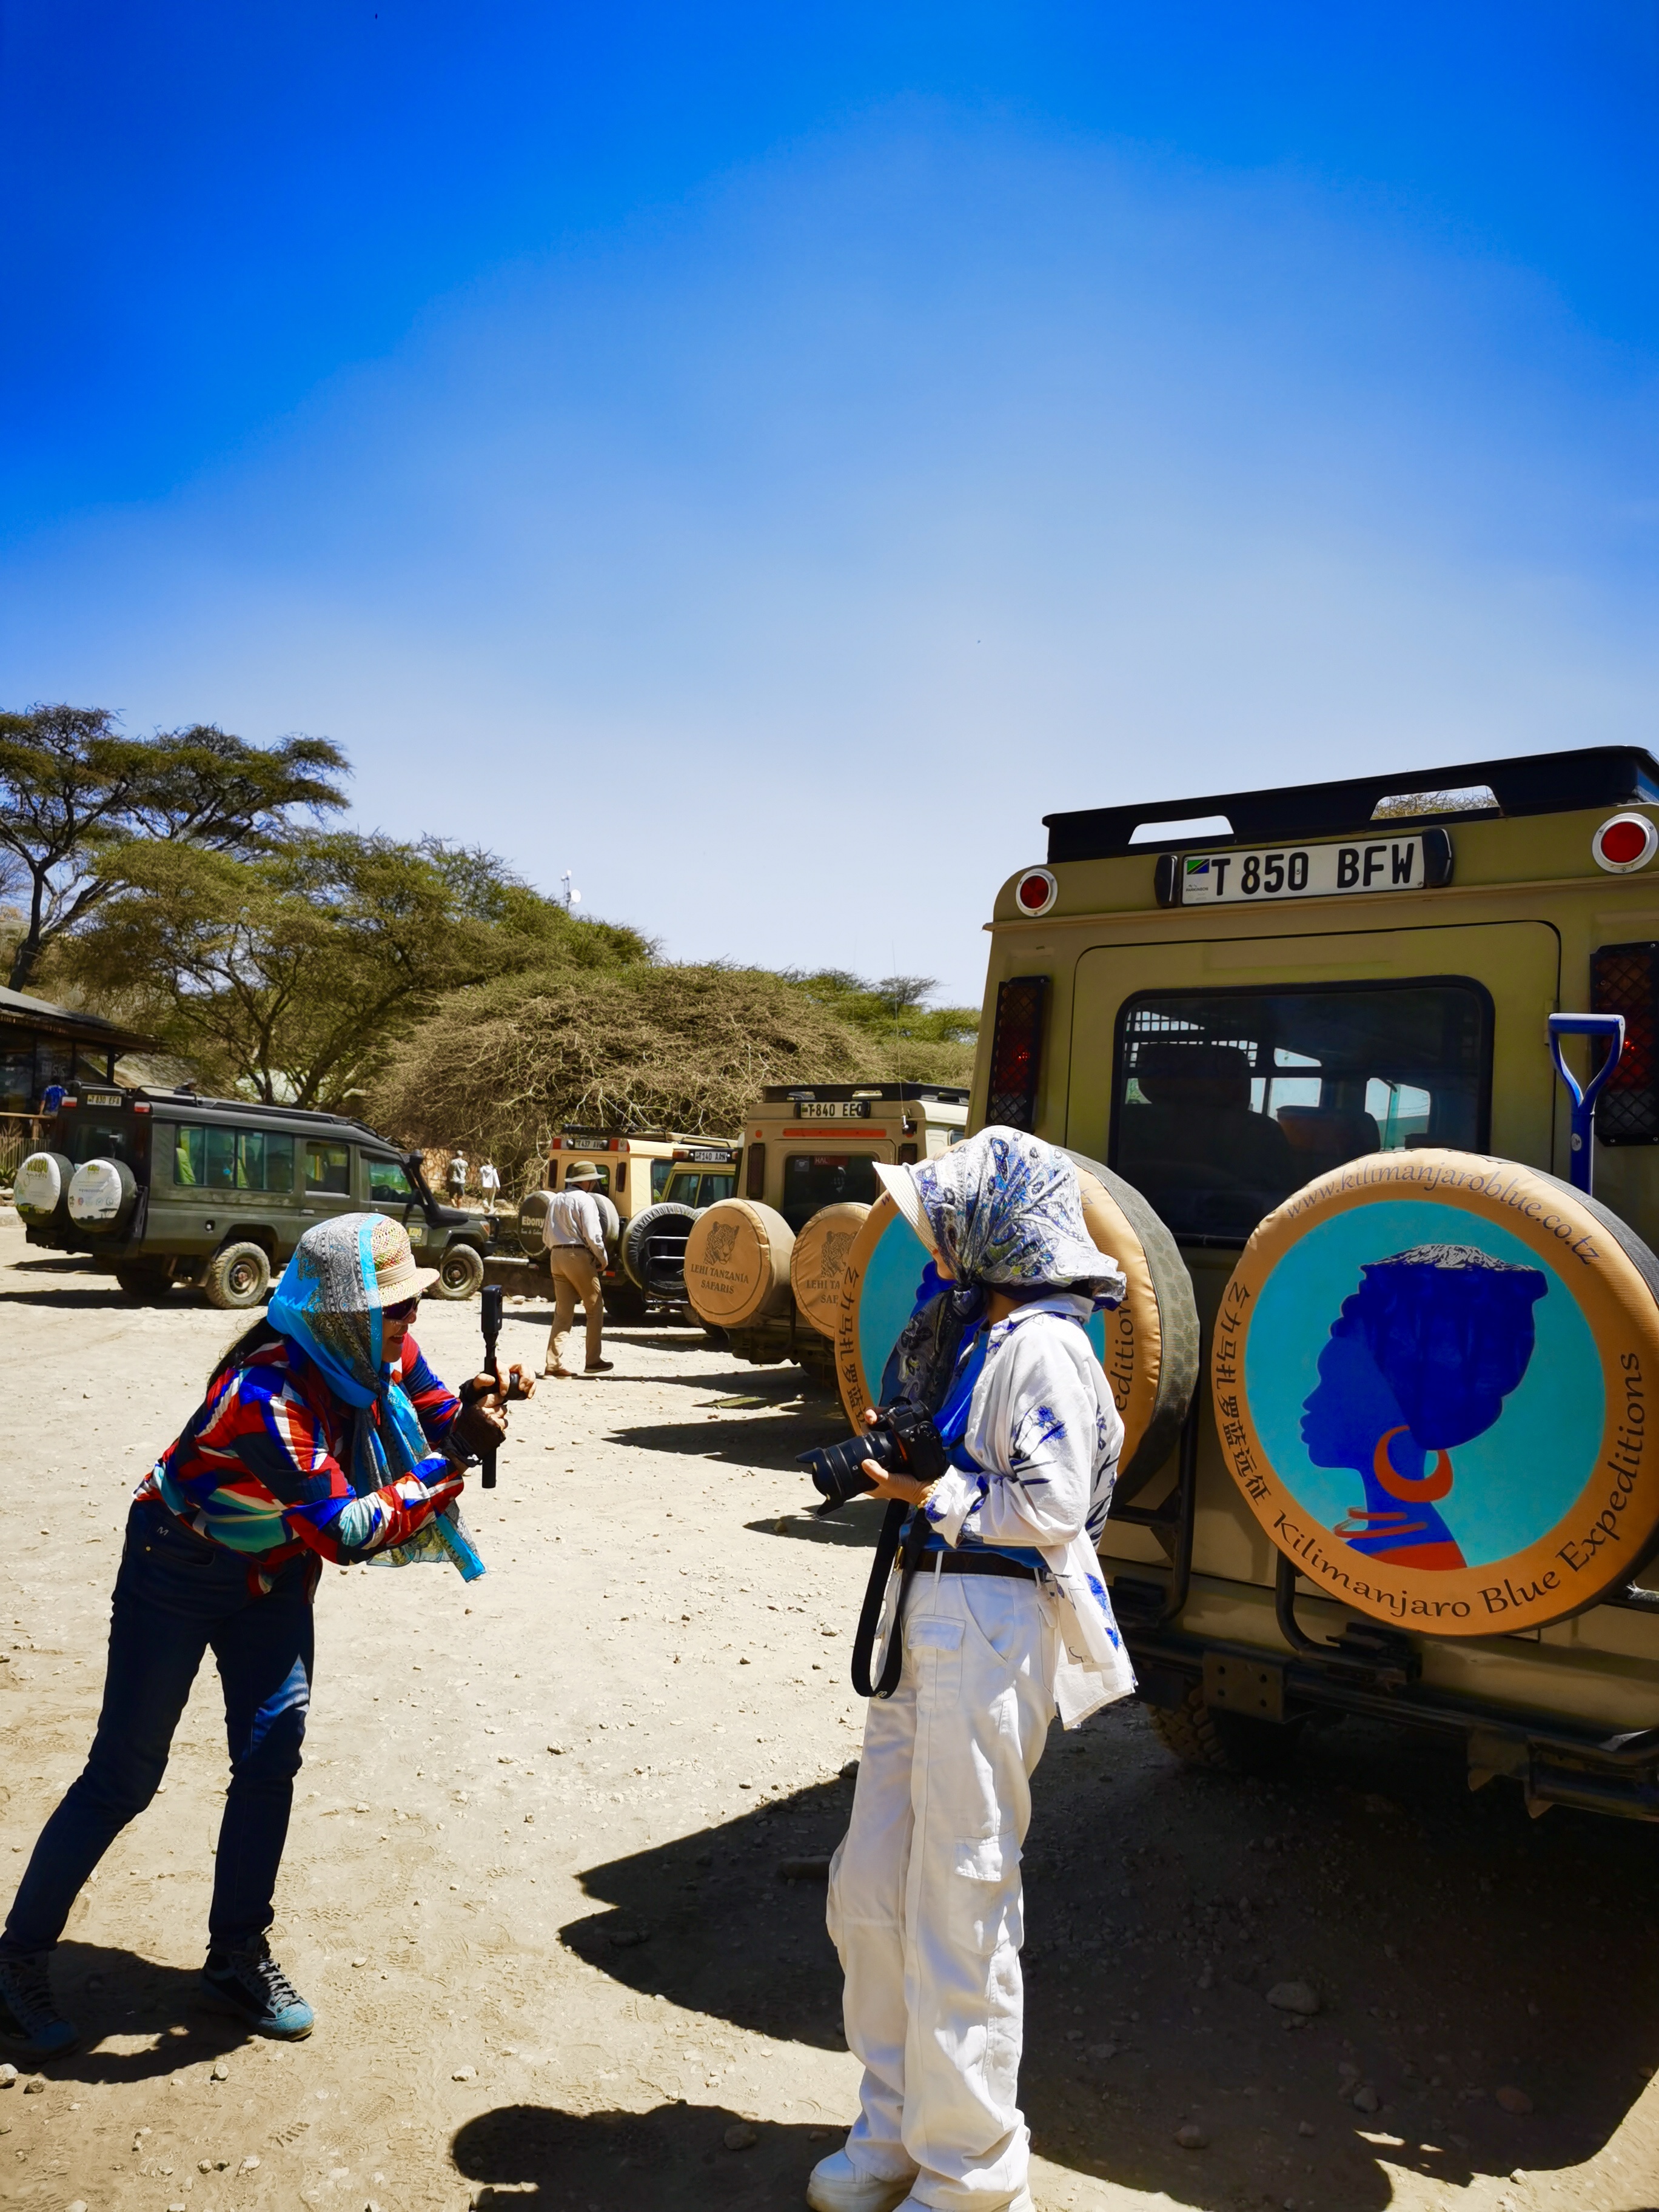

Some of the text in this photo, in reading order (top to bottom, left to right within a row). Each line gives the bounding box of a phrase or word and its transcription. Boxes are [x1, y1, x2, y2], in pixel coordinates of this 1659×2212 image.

[1211, 842, 1415, 896] T 850 BFW
[816, 1104, 836, 1116] 840
[521, 1215, 545, 1228] Ebony
[1286, 1159, 1601, 1267] www.kilimanjaroblue.co.tz
[690, 1263, 749, 1284] LEHI TANZANIA
[806, 1279, 828, 1289] LEHI
[700, 1278, 735, 1295] SAFARIS
[1215, 1280, 1272, 1506] 乞力马扎罗蓝远征
[1272, 1352, 1646, 1618] Kilimanjaro Blue Expeditions
